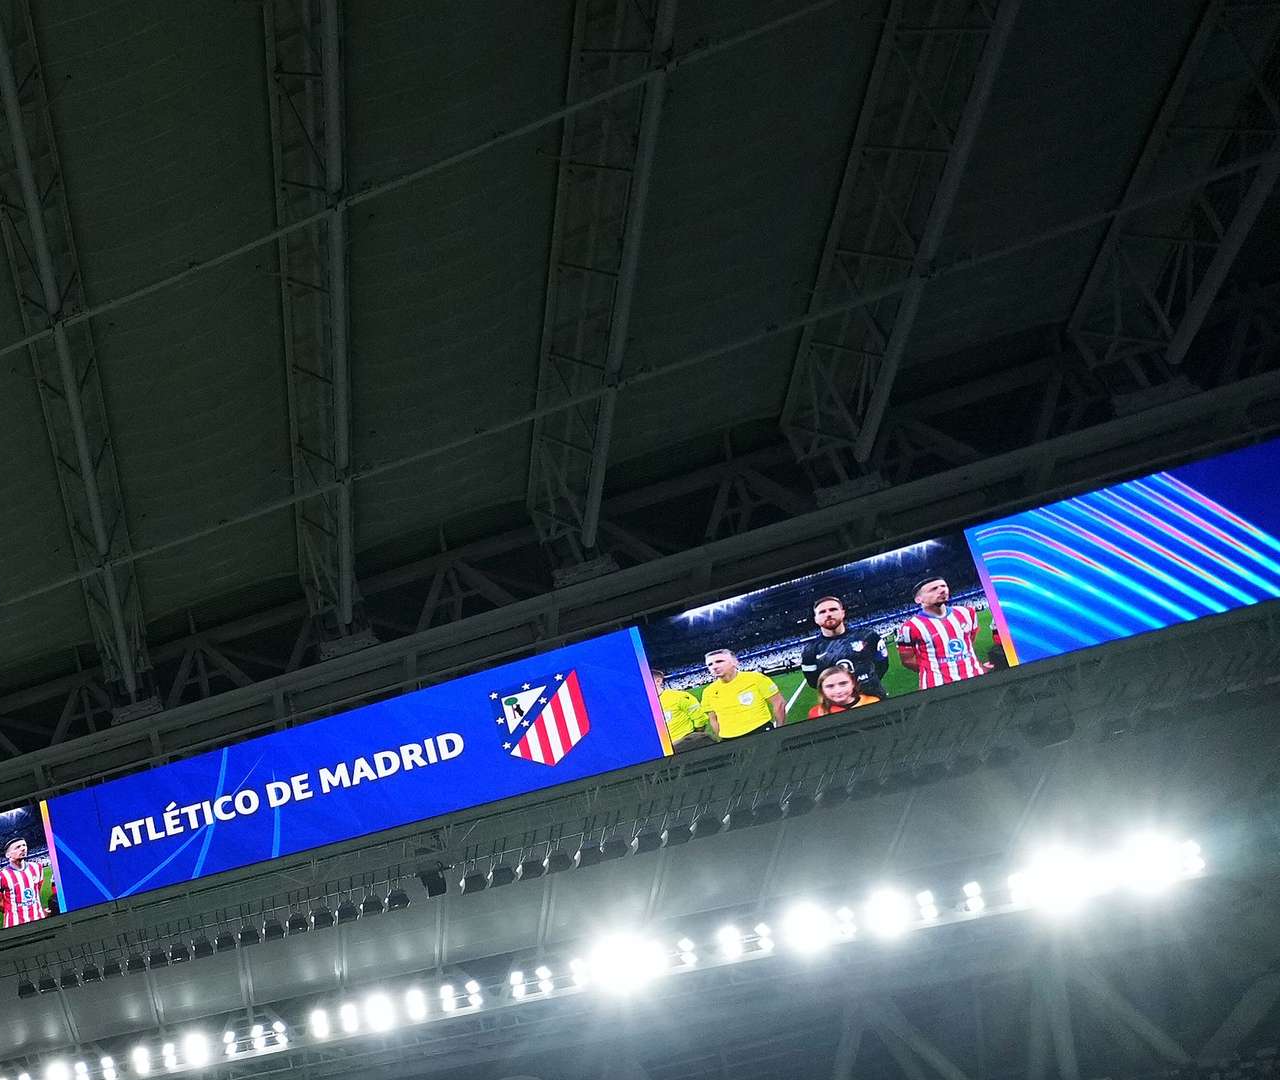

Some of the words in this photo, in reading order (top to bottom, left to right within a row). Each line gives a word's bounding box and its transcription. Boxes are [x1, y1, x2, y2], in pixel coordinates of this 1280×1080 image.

[108, 788, 260, 853] ATLÉTICO
[266, 773, 314, 809] DE
[320, 731, 465, 796] MADRID
